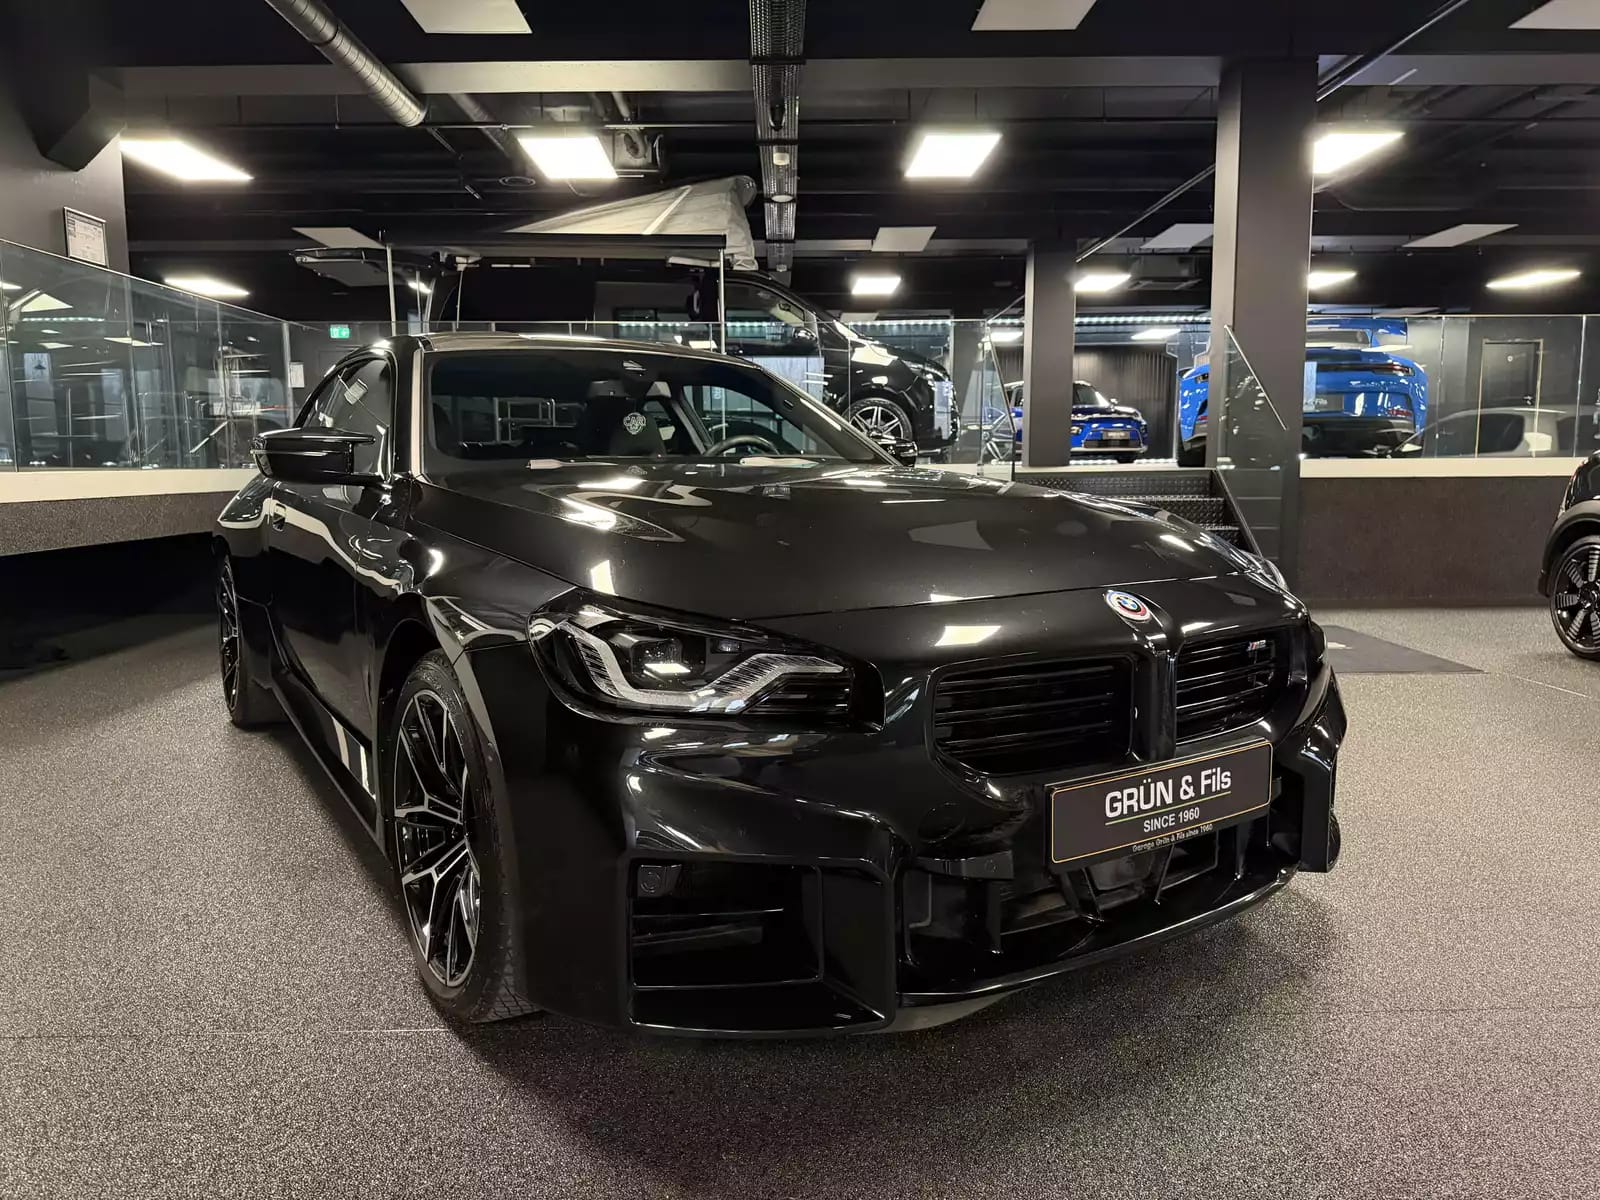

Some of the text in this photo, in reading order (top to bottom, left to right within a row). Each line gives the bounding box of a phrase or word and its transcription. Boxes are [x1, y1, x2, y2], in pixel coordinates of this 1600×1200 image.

[1105, 767, 1231, 818] GRÜN & Fils
[1143, 807, 1200, 833] SINCE 1960
[1132, 841, 1155, 853] Garage
